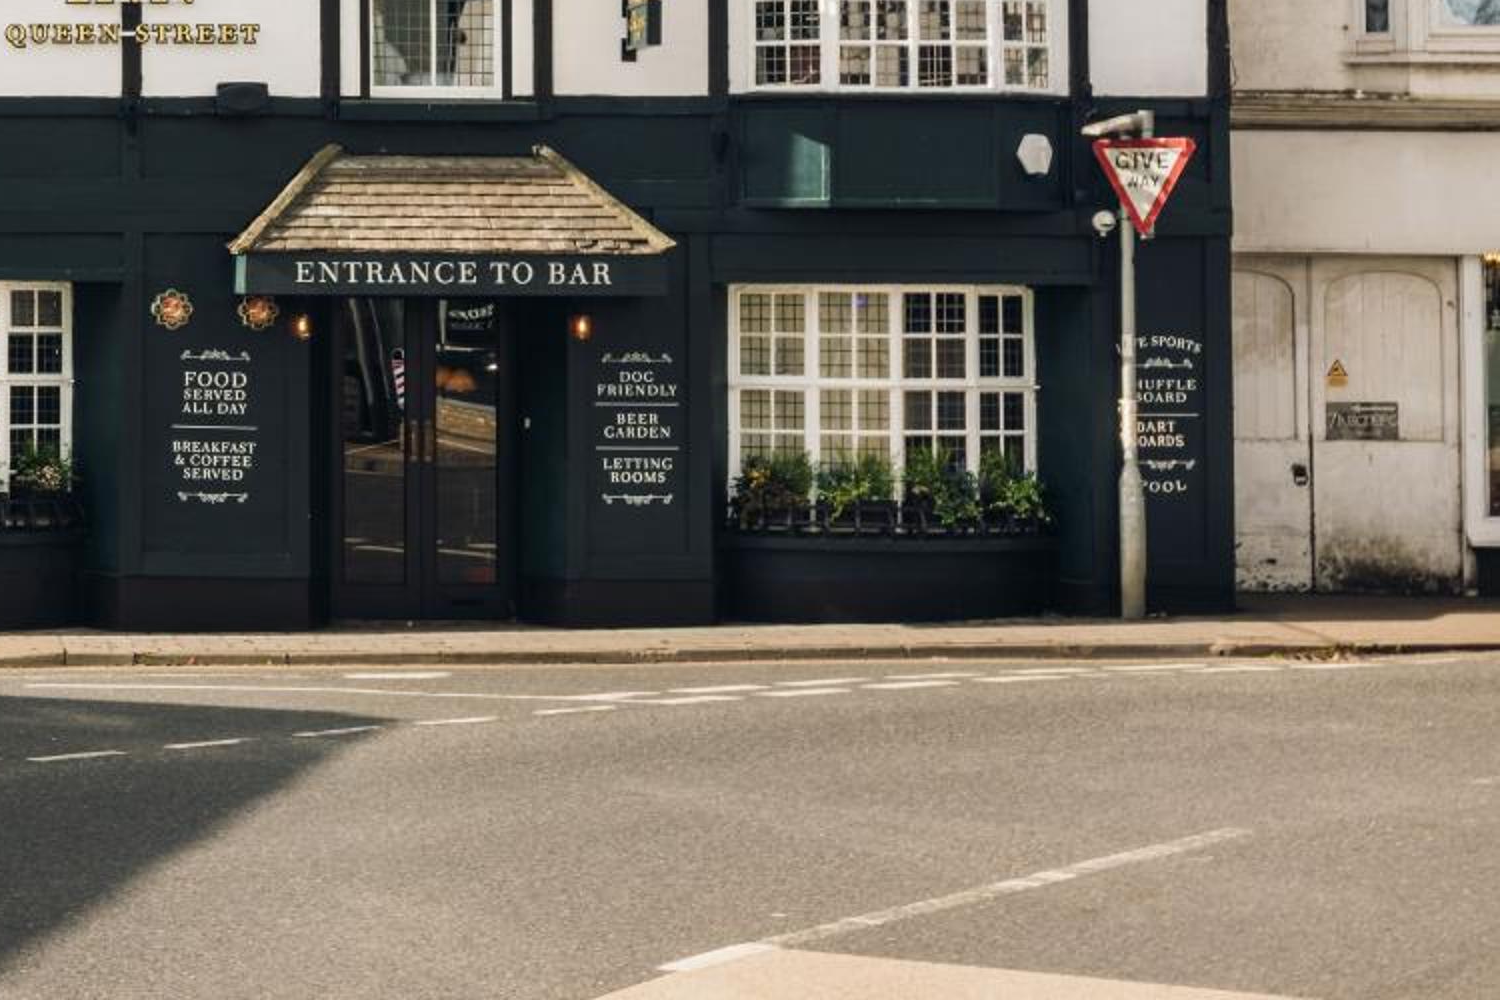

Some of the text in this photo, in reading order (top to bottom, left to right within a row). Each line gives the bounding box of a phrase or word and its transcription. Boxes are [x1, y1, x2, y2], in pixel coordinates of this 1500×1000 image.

[5, 23, 261, 48] QUEEN STREET
[1115, 151, 1169, 169] GIVE
[295, 261, 612, 285] ENTRANCE TO BAR
[185, 371, 248, 388] FOOD
[619, 371, 655, 383] DOG
[597, 383, 677, 397] FRIENDLY
[1138, 379, 1197, 391] UFFLE
[183, 388, 247, 401] SERVED
[182, 402, 247, 415] ALL DAY
[616, 413, 659, 425] BEER
[603, 425, 671, 439] GARDEN
[1137, 421, 1176, 433] DART
[1139, 434, 1185, 447] OARDS
[173, 441, 256, 454] BREAKFAST
[174, 454, 252, 467] & COFFEE
[603, 457, 673, 470] LETTING
[183, 467, 243, 480] SERVED
[611, 471, 666, 484] ROOMS
